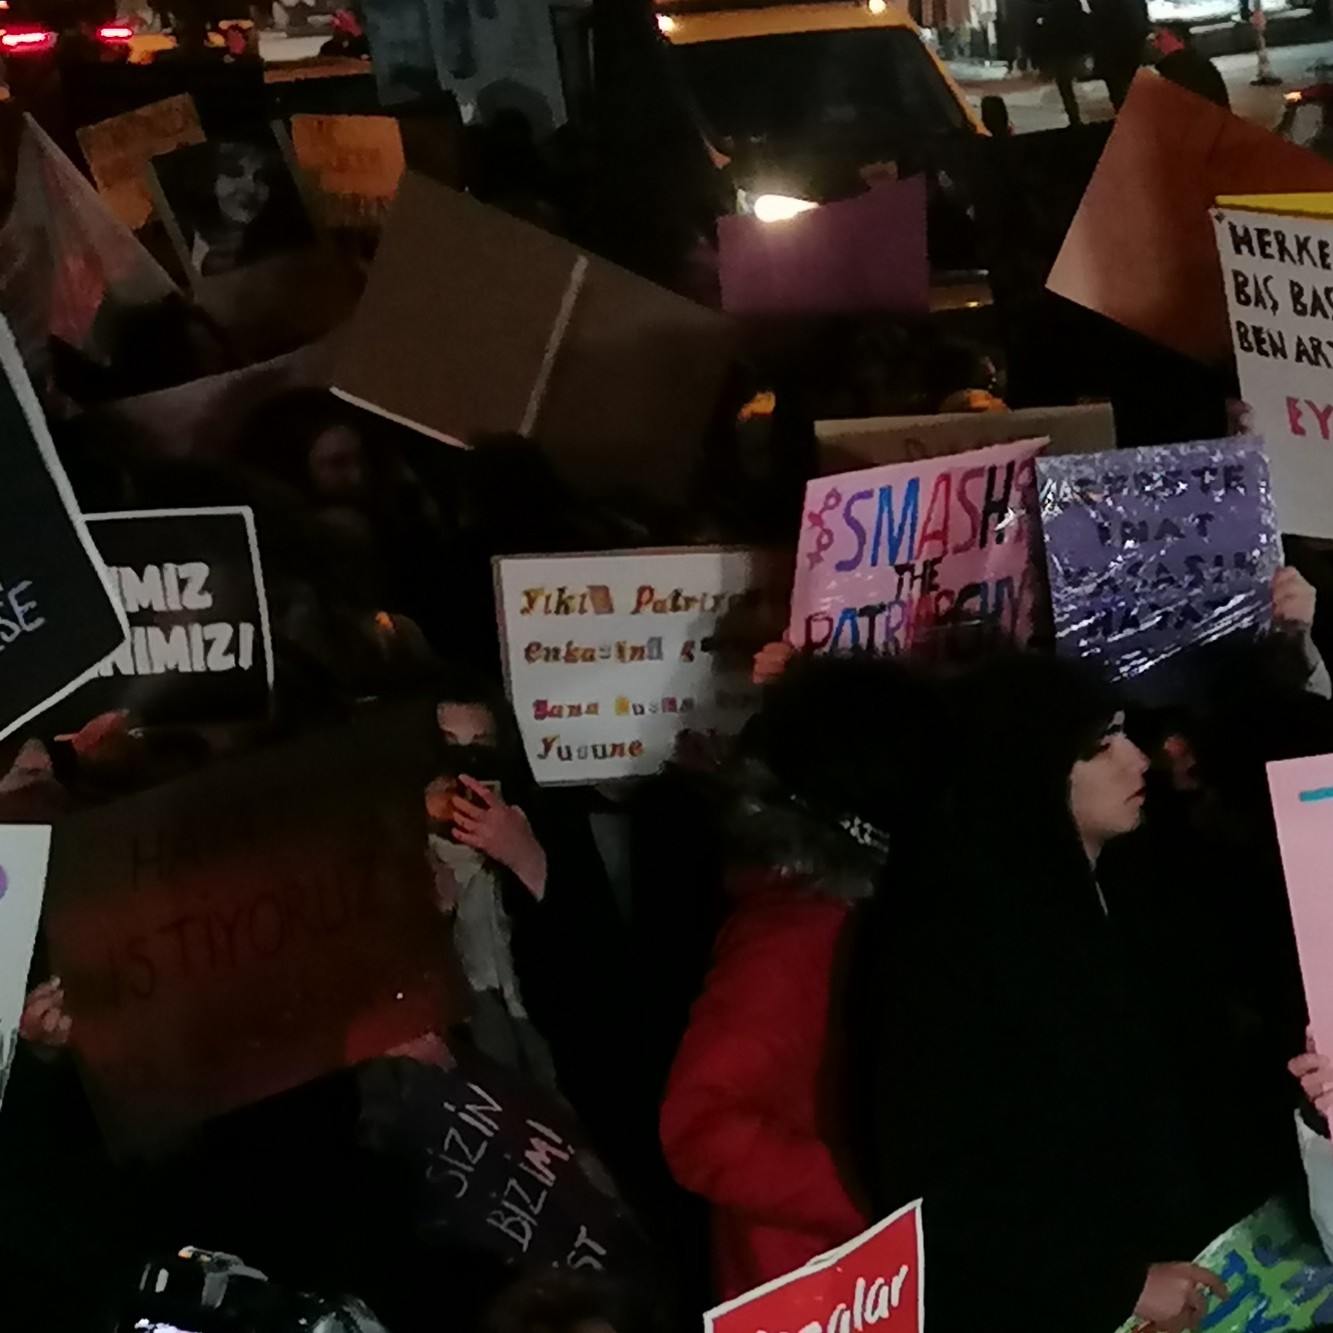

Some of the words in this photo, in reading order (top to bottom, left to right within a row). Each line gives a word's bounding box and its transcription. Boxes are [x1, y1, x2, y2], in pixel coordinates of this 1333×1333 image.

[1236, 321, 1286, 360] BEN
[835, 459, 1016, 572] SMASH
[894, 558, 945, 600] THE
